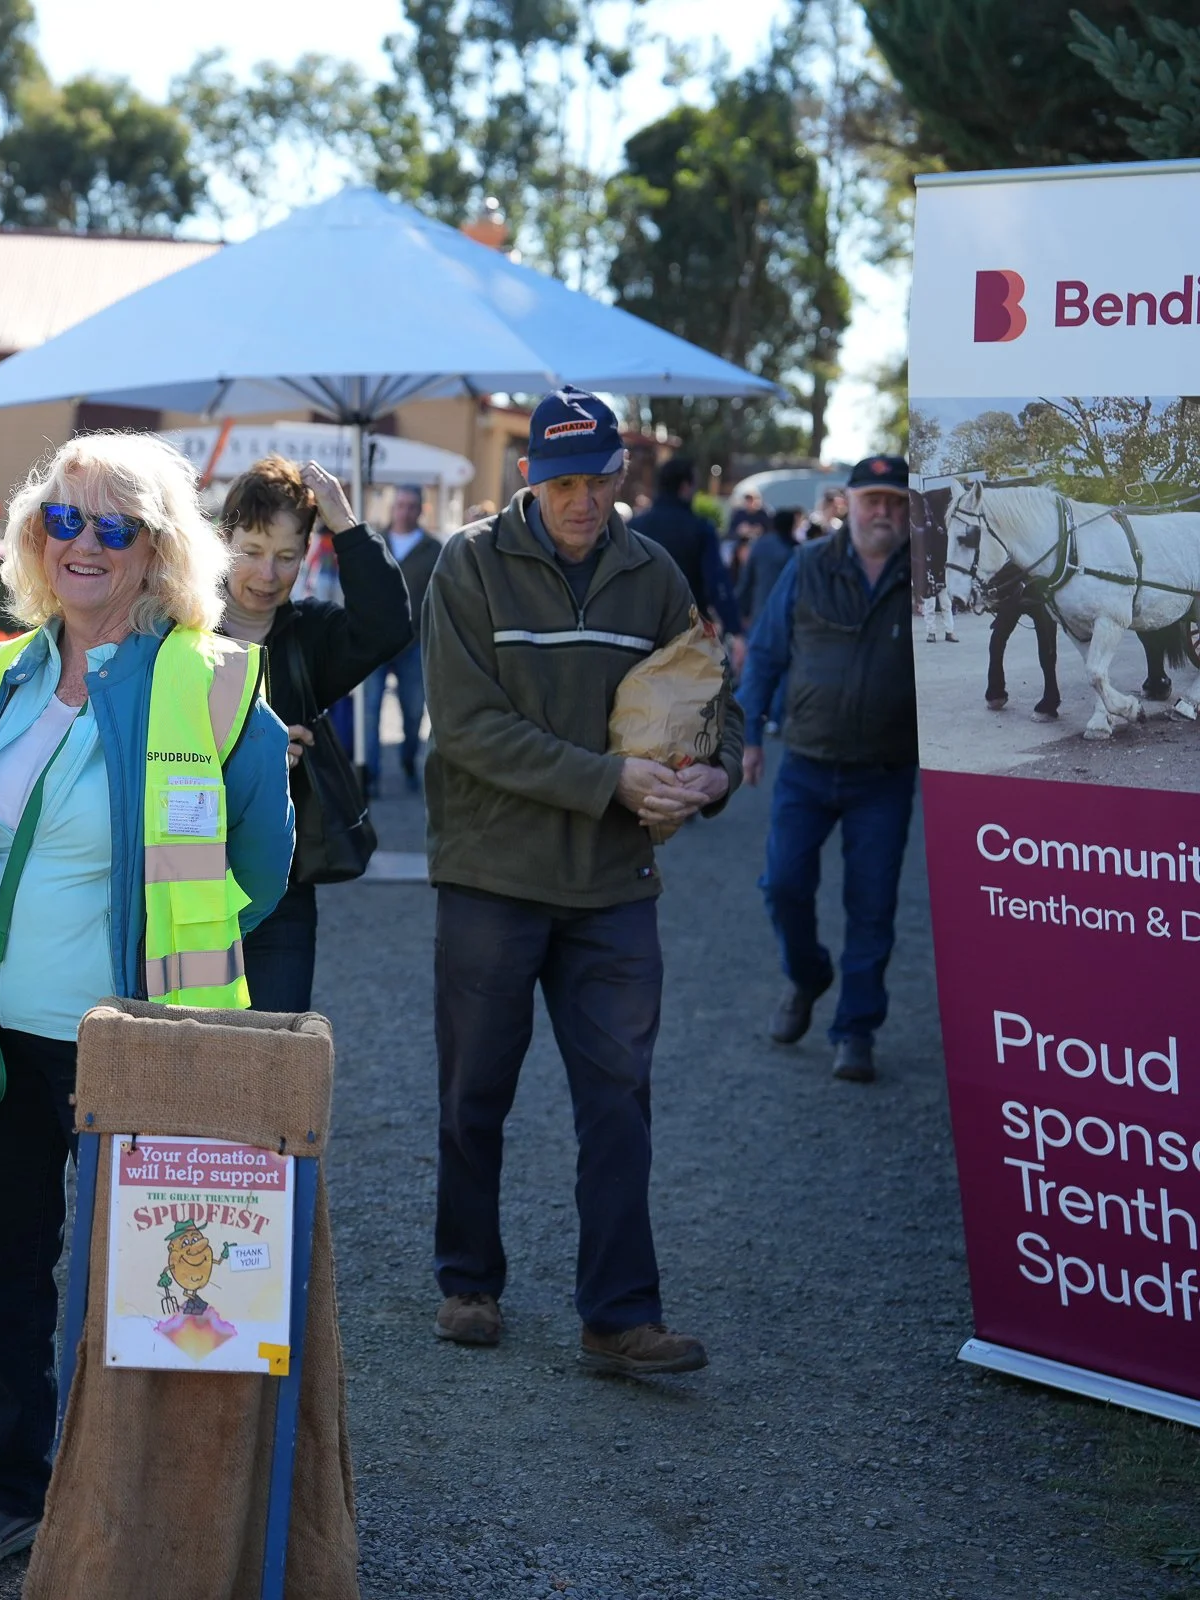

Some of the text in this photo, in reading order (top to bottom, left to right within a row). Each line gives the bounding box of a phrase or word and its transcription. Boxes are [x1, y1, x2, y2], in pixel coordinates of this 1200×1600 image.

[547, 421, 595, 435] WARATAH
[147, 752, 211, 764] SPUDBUDDY
[976, 823, 1200, 884] Communit
[980, 885, 1135, 934] Trentham
[1146, 907, 1171, 938] &
[993, 1010, 1179, 1095] Proud
[1001, 1100, 1200, 1172] spons
[138, 1146, 267, 1166] Your donation
[126, 1164, 280, 1187] will help support
[147, 1191, 259, 1204] THE GREAT TRENTHAM
[1003, 1157, 1198, 1250] Trenth
[133, 1202, 271, 1236] SPUDFEST
[235, 1248, 263, 1258] THANK
[240, 1257, 260, 1267] YOU!
